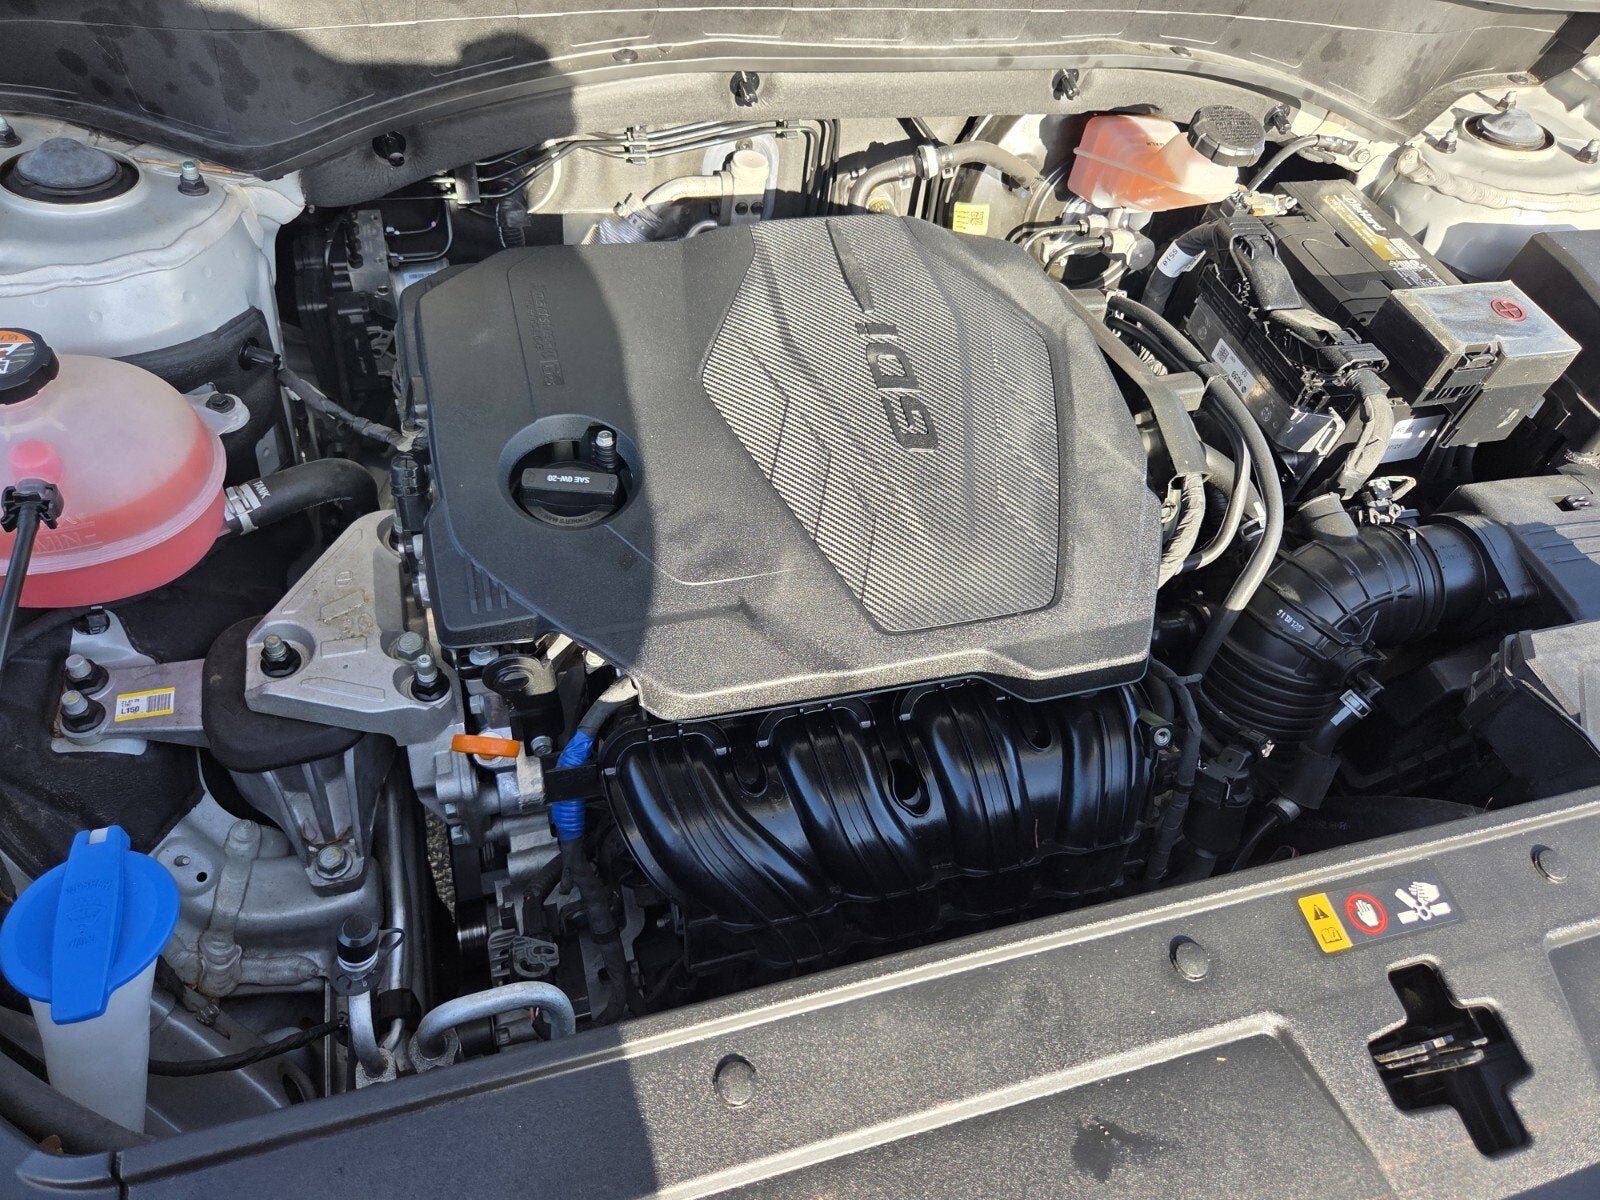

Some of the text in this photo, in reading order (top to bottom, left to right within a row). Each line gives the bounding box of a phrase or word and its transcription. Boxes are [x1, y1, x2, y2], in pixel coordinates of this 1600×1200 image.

[1343, 196, 1387, 232] DieHard
[855, 322, 940, 453] GDi
[547, 474, 590, 484] SAE 0W-20
[253, 480, 271, 499] TANK
[121, 706, 140, 715] L150
